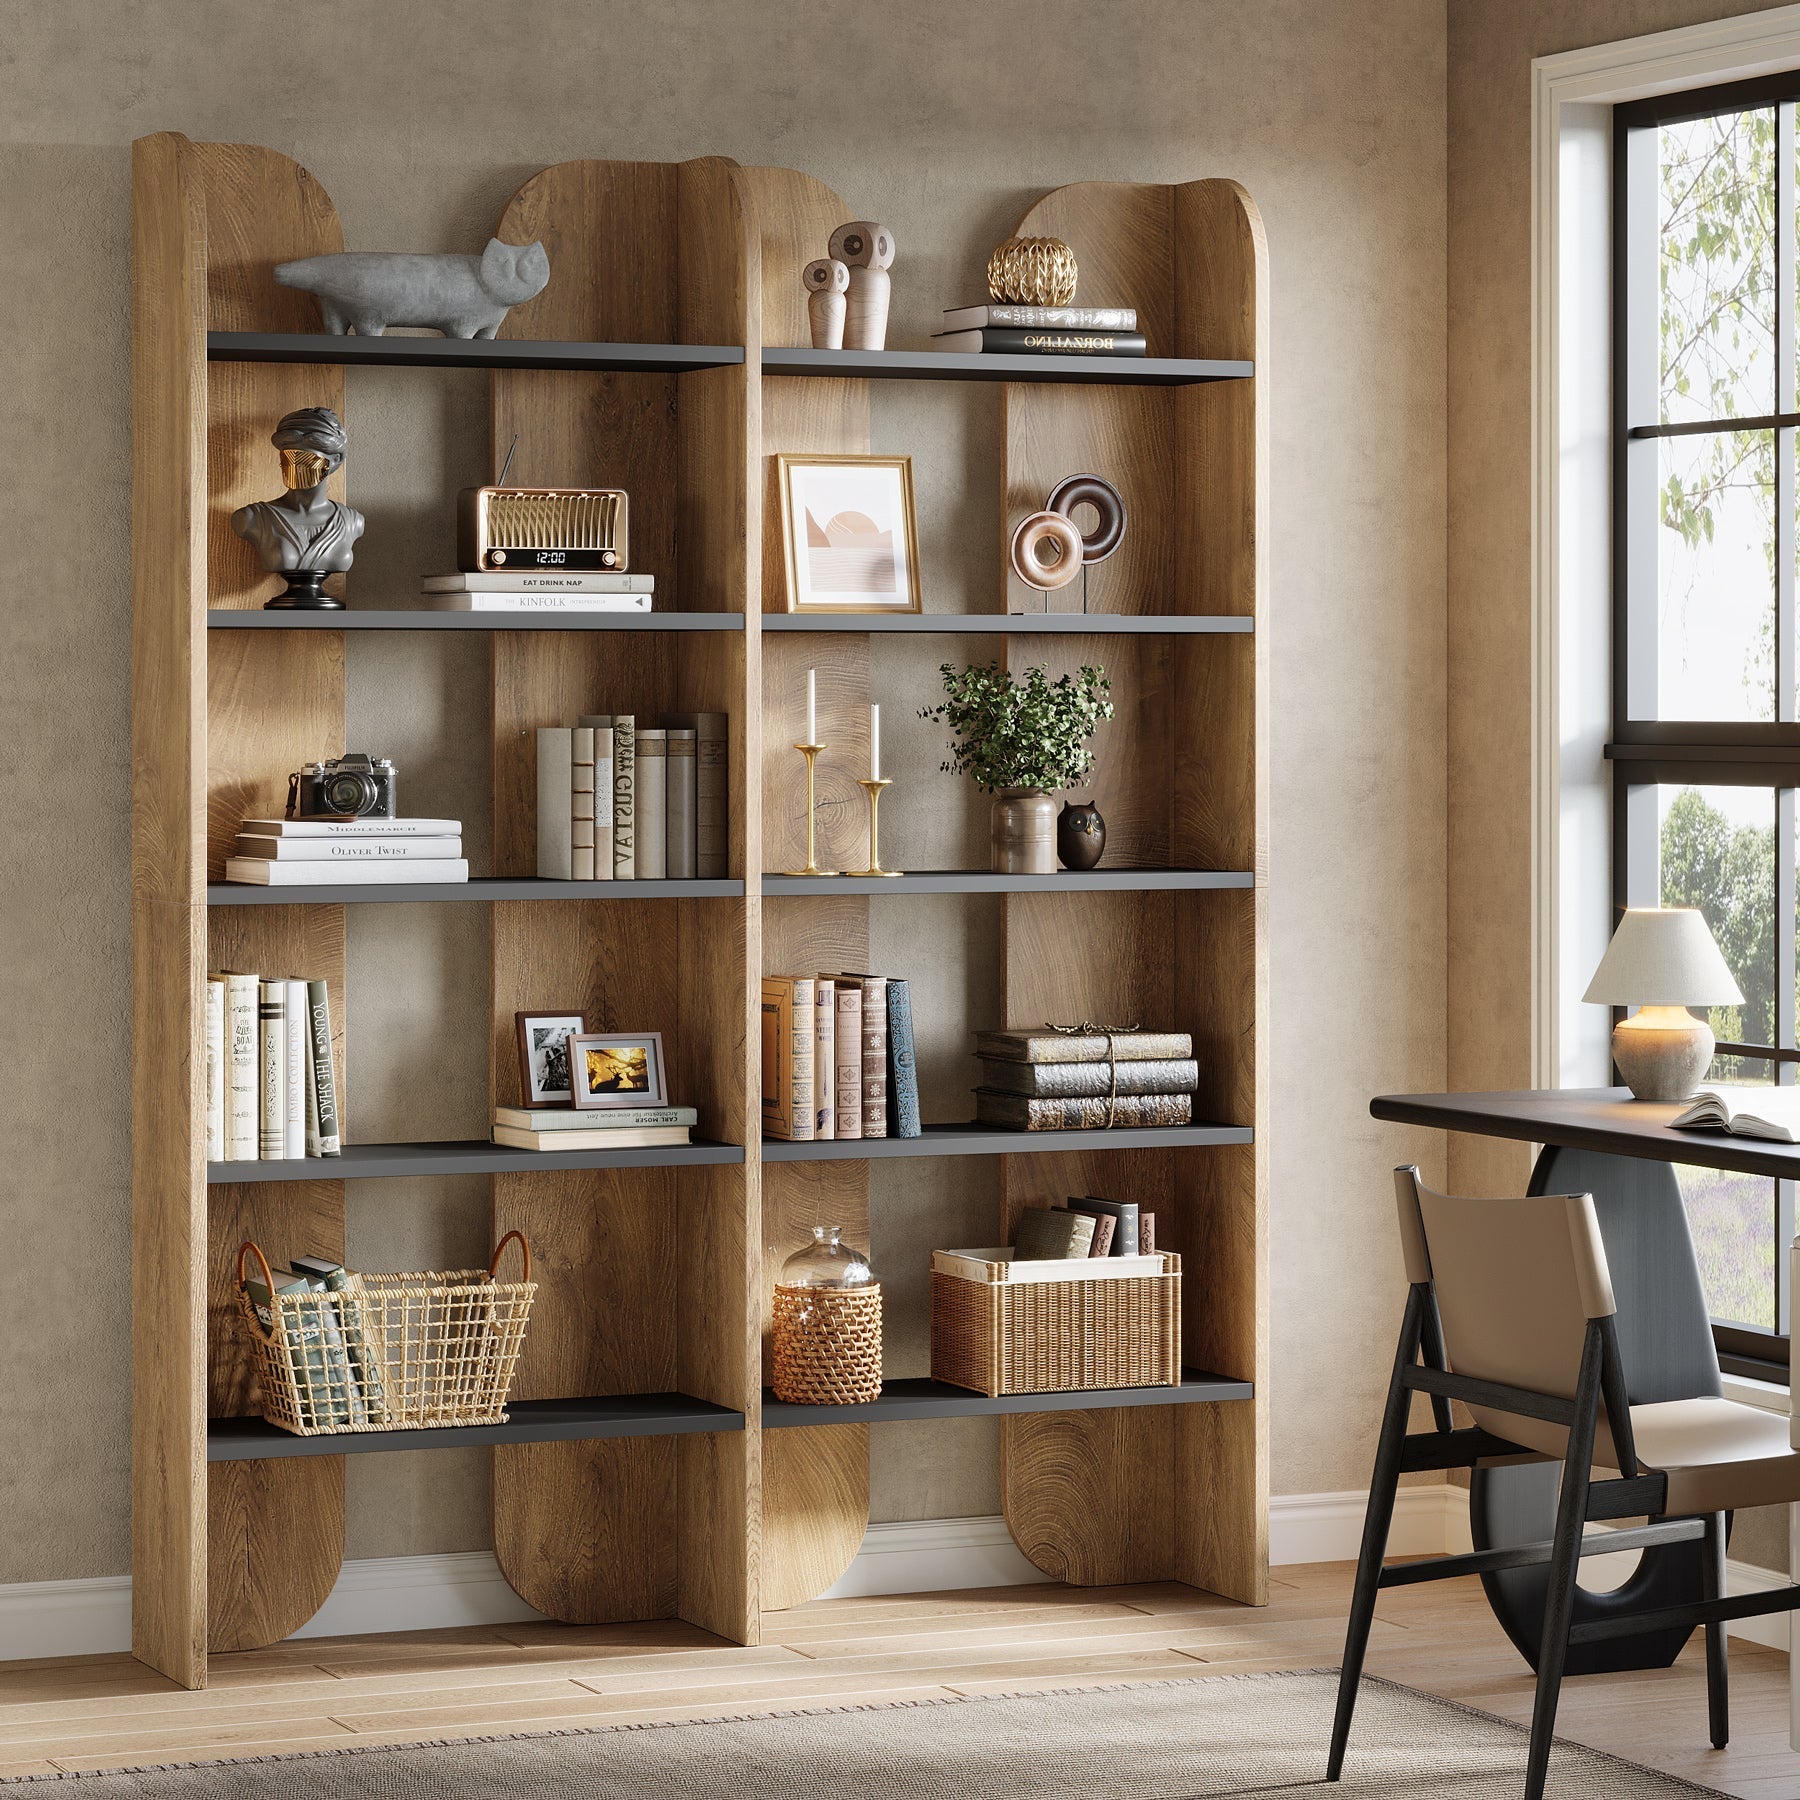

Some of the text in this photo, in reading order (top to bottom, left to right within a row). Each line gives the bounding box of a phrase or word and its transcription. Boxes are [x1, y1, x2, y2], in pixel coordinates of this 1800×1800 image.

[536, 552, 566, 564] 12:00
[520, 597, 566, 606] KINFOLK
[331, 846, 408, 855] OLIVER TWIST
[313, 1002, 334, 1123] YOUNG THE SHACK
